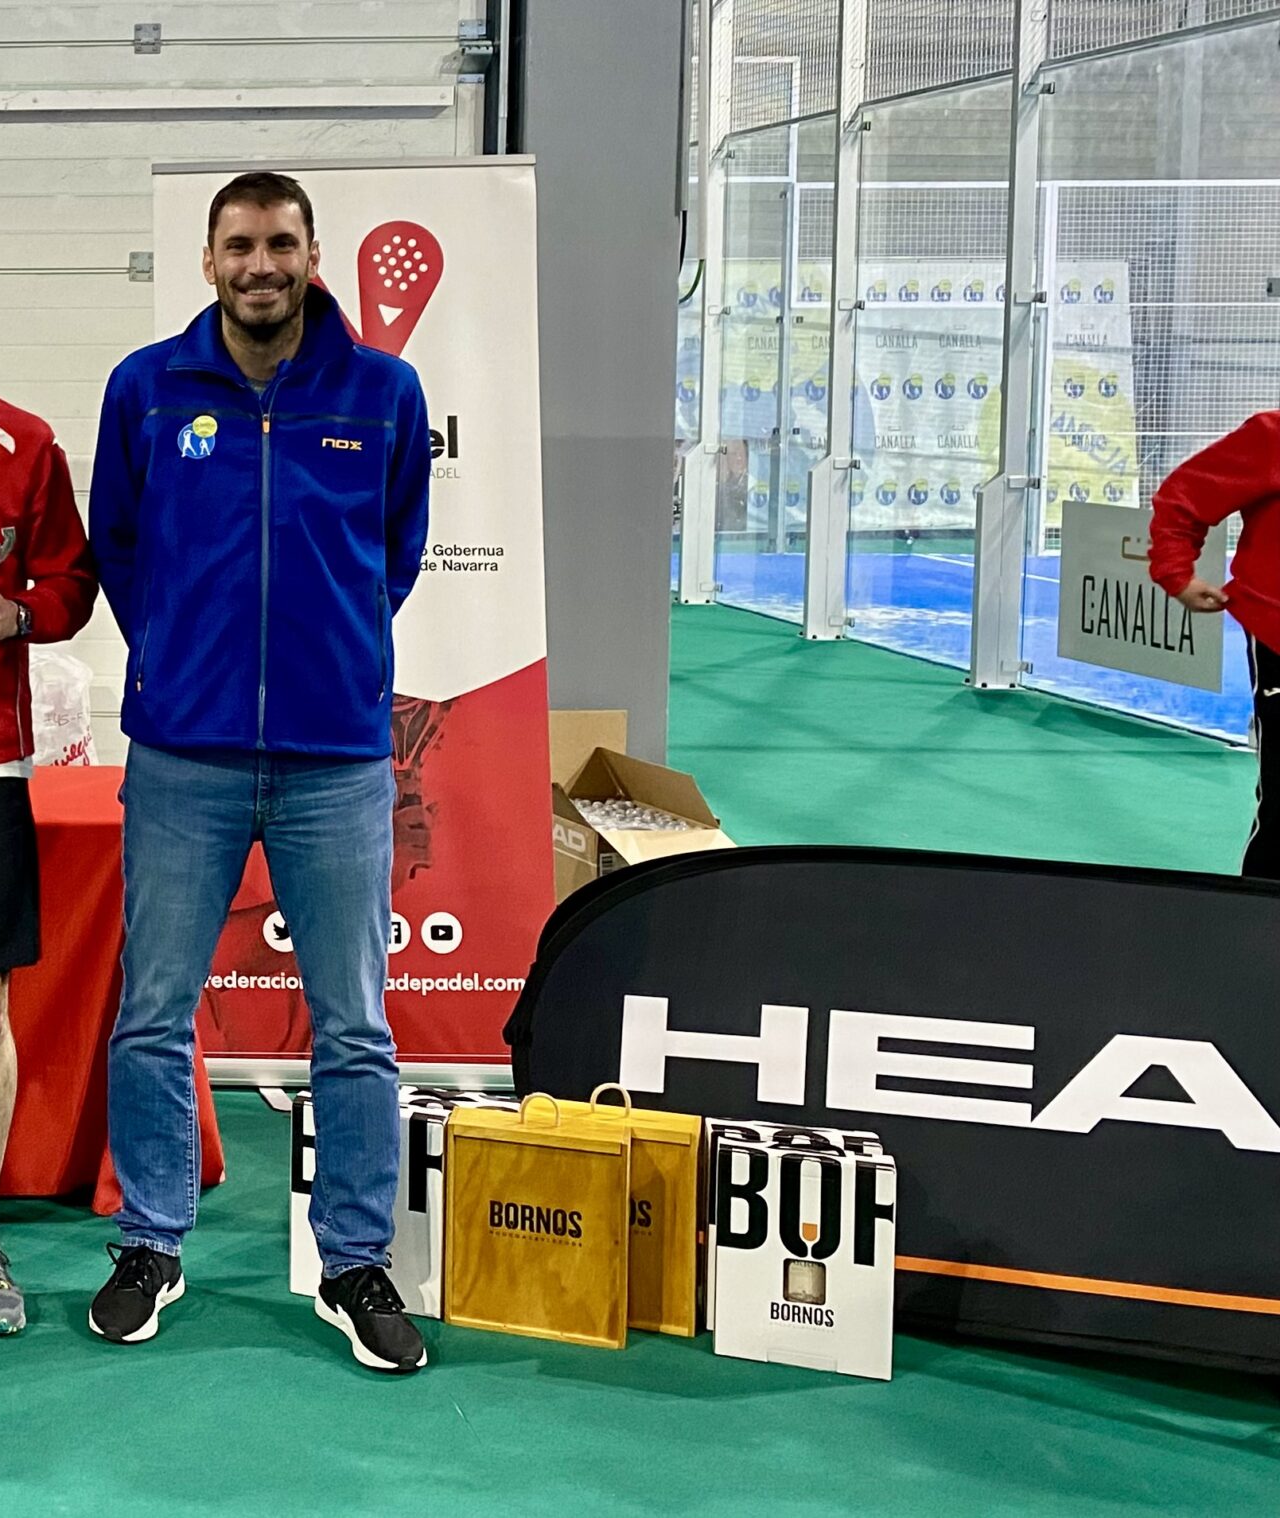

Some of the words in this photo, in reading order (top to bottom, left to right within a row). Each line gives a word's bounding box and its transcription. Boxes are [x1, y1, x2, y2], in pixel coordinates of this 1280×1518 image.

[875, 334, 918, 348] CANALLA
[939, 334, 982, 348] CANALLA
[874, 434, 917, 448] CANALLA
[432, 544, 504, 557] Gobernua
[442, 559, 498, 572] Navarra
[1081, 575, 1195, 656] CANALLA
[489, 1200, 583, 1239] BORNOS
[770, 1302, 835, 1328] BORNOS
